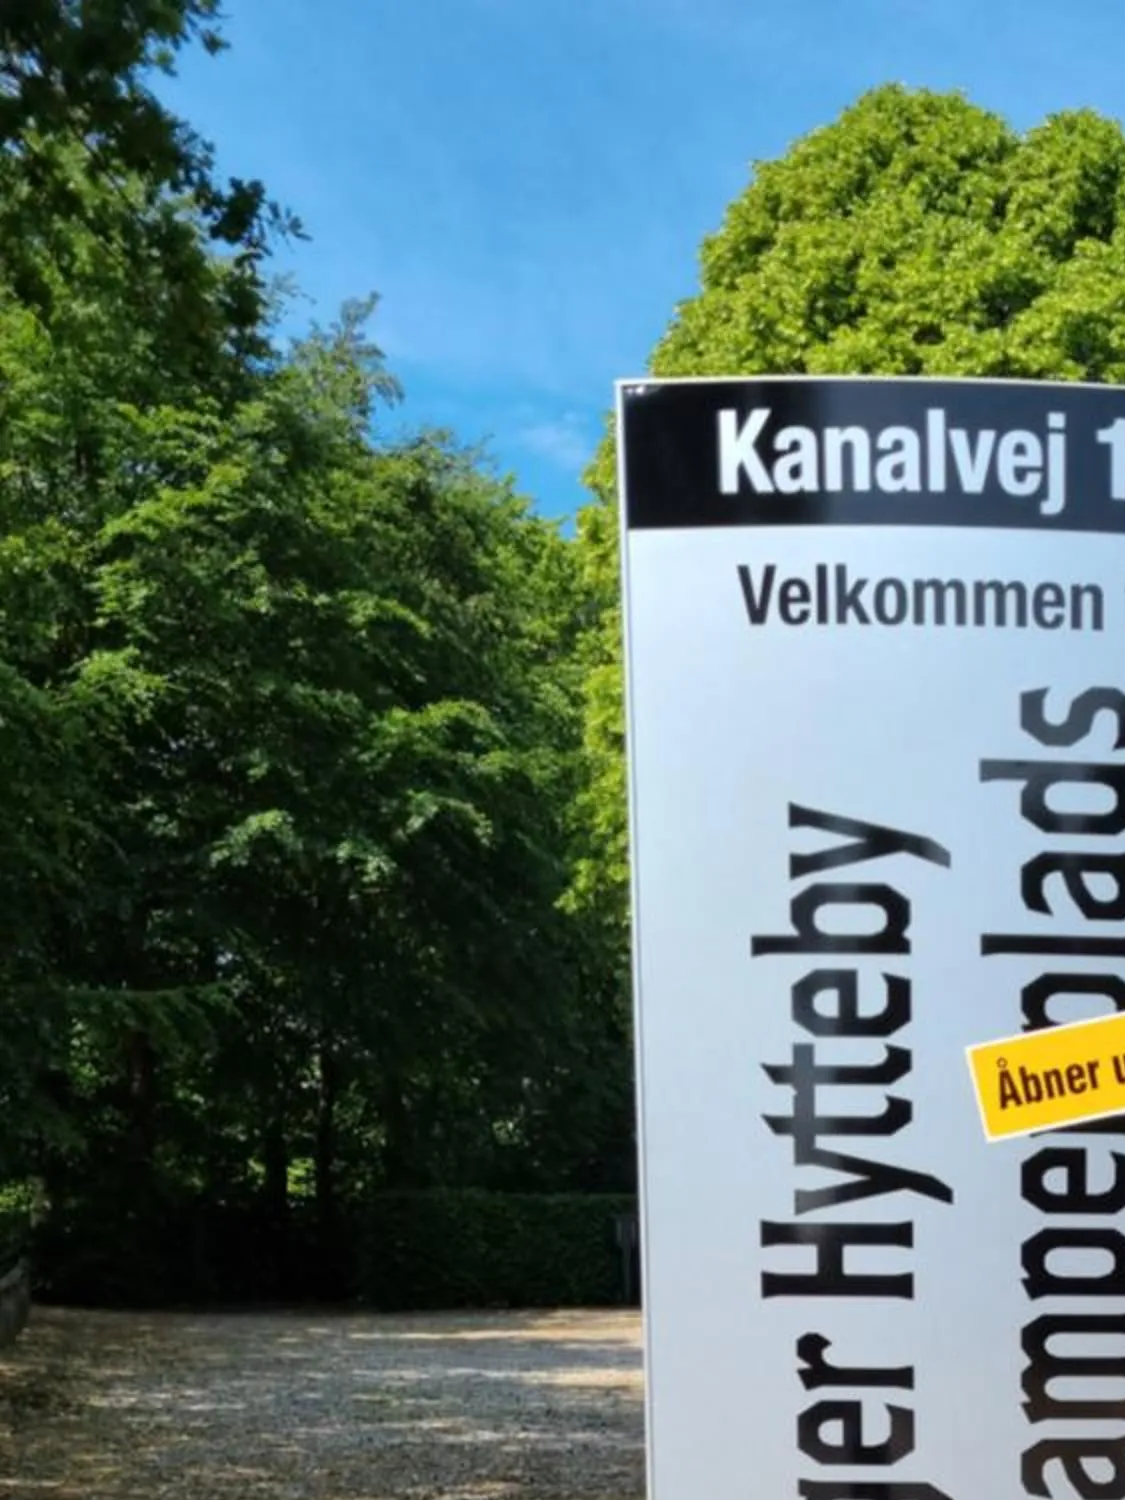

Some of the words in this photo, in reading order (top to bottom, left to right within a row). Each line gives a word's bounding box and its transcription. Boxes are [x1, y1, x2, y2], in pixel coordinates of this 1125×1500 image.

[717, 408, 1065, 515] Kanalvej
[737, 563, 1104, 631] Velkommen
[750, 802, 954, 1301] Hytteby
[996, 1057, 1100, 1110] Åbner
